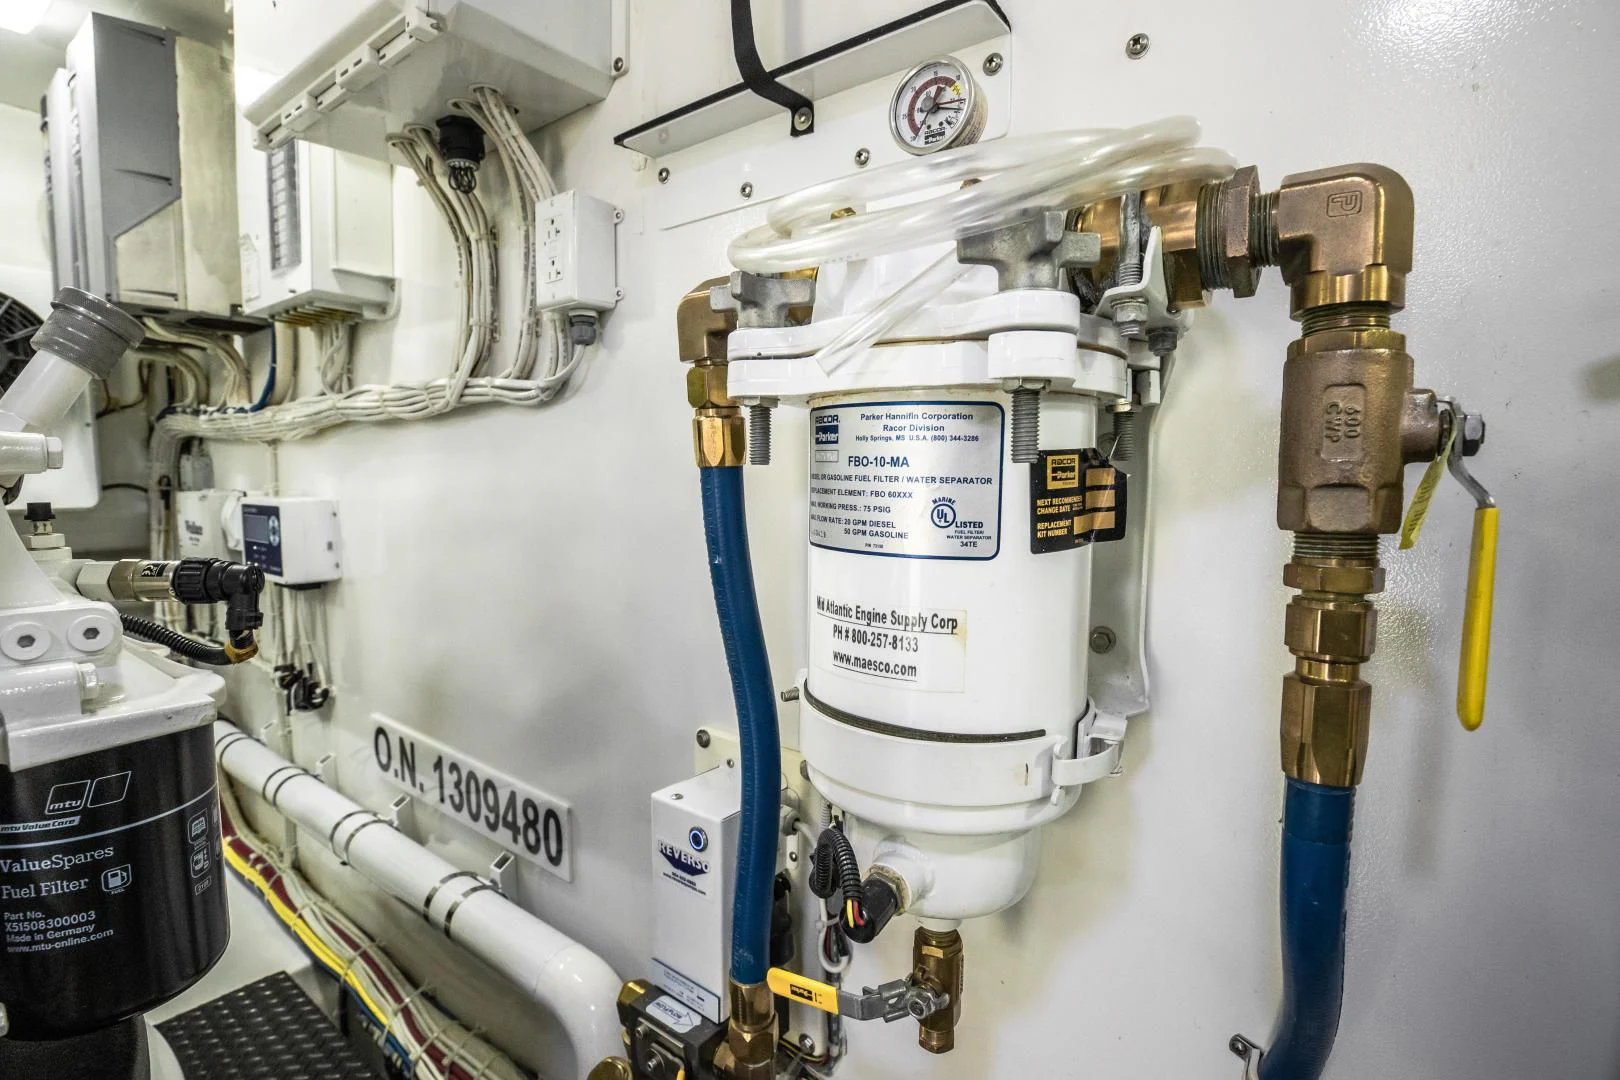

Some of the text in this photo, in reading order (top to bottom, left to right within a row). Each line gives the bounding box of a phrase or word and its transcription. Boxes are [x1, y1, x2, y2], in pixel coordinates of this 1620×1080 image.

[860, 412, 974, 421] Parker Hannifin Corporation
[1325, 401, 1342, 443] CWP
[1344, 406, 1361, 439] 600
[882, 424, 945, 432] Racor Division
[818, 432, 838, 442] Parker
[848, 455, 909, 468] FBO-10-MA
[1051, 458, 1076, 466] RACOR
[906, 476, 937, 484] WATER
[939, 477, 993, 485] SEPARATOR
[1057, 471, 1075, 480] Parker
[837, 489, 868, 497] ELEMENT:
[887, 491, 913, 499] 60XXX
[817, 501, 836, 510] WORKING
[873, 505, 891, 513] PSIG
[932, 496, 956, 506] MARINE
[1060, 505, 1071, 513] DATE
[817, 514, 827, 523] FLOW
[829, 517, 844, 525] RATE:
[869, 520, 896, 529] DIESEL
[937, 509, 984, 529] UL LISTED
[1037, 520, 1071, 530] REPLACEMENT
[844, 527, 909, 539] 50 GPM GASOLINE
[1037, 528, 1068, 538] KIT NUMBER
[816, 595, 958, 634] Mid Atlantic Engine Supply Corp
[833, 624, 919, 652] PH # 800-257-8133
[833, 650, 917, 677] www.maesco.com
[374, 726, 563, 867] O.N. 1309480
[49, 800, 81, 810] mtu
[22, 823, 51, 831] Value
[52, 819, 76, 827] Care
[0, 847, 114, 873] ValueSpares
[658, 840, 710, 873] REVERSO
[1, 878, 89, 899] Fuel Filter
[4, 911, 46, 921] Part No.
[5, 910, 96, 932] X51508300003
[6, 923, 95, 942] Made in Germany
[7, 929, 114, 953] www.mtu-online.com
